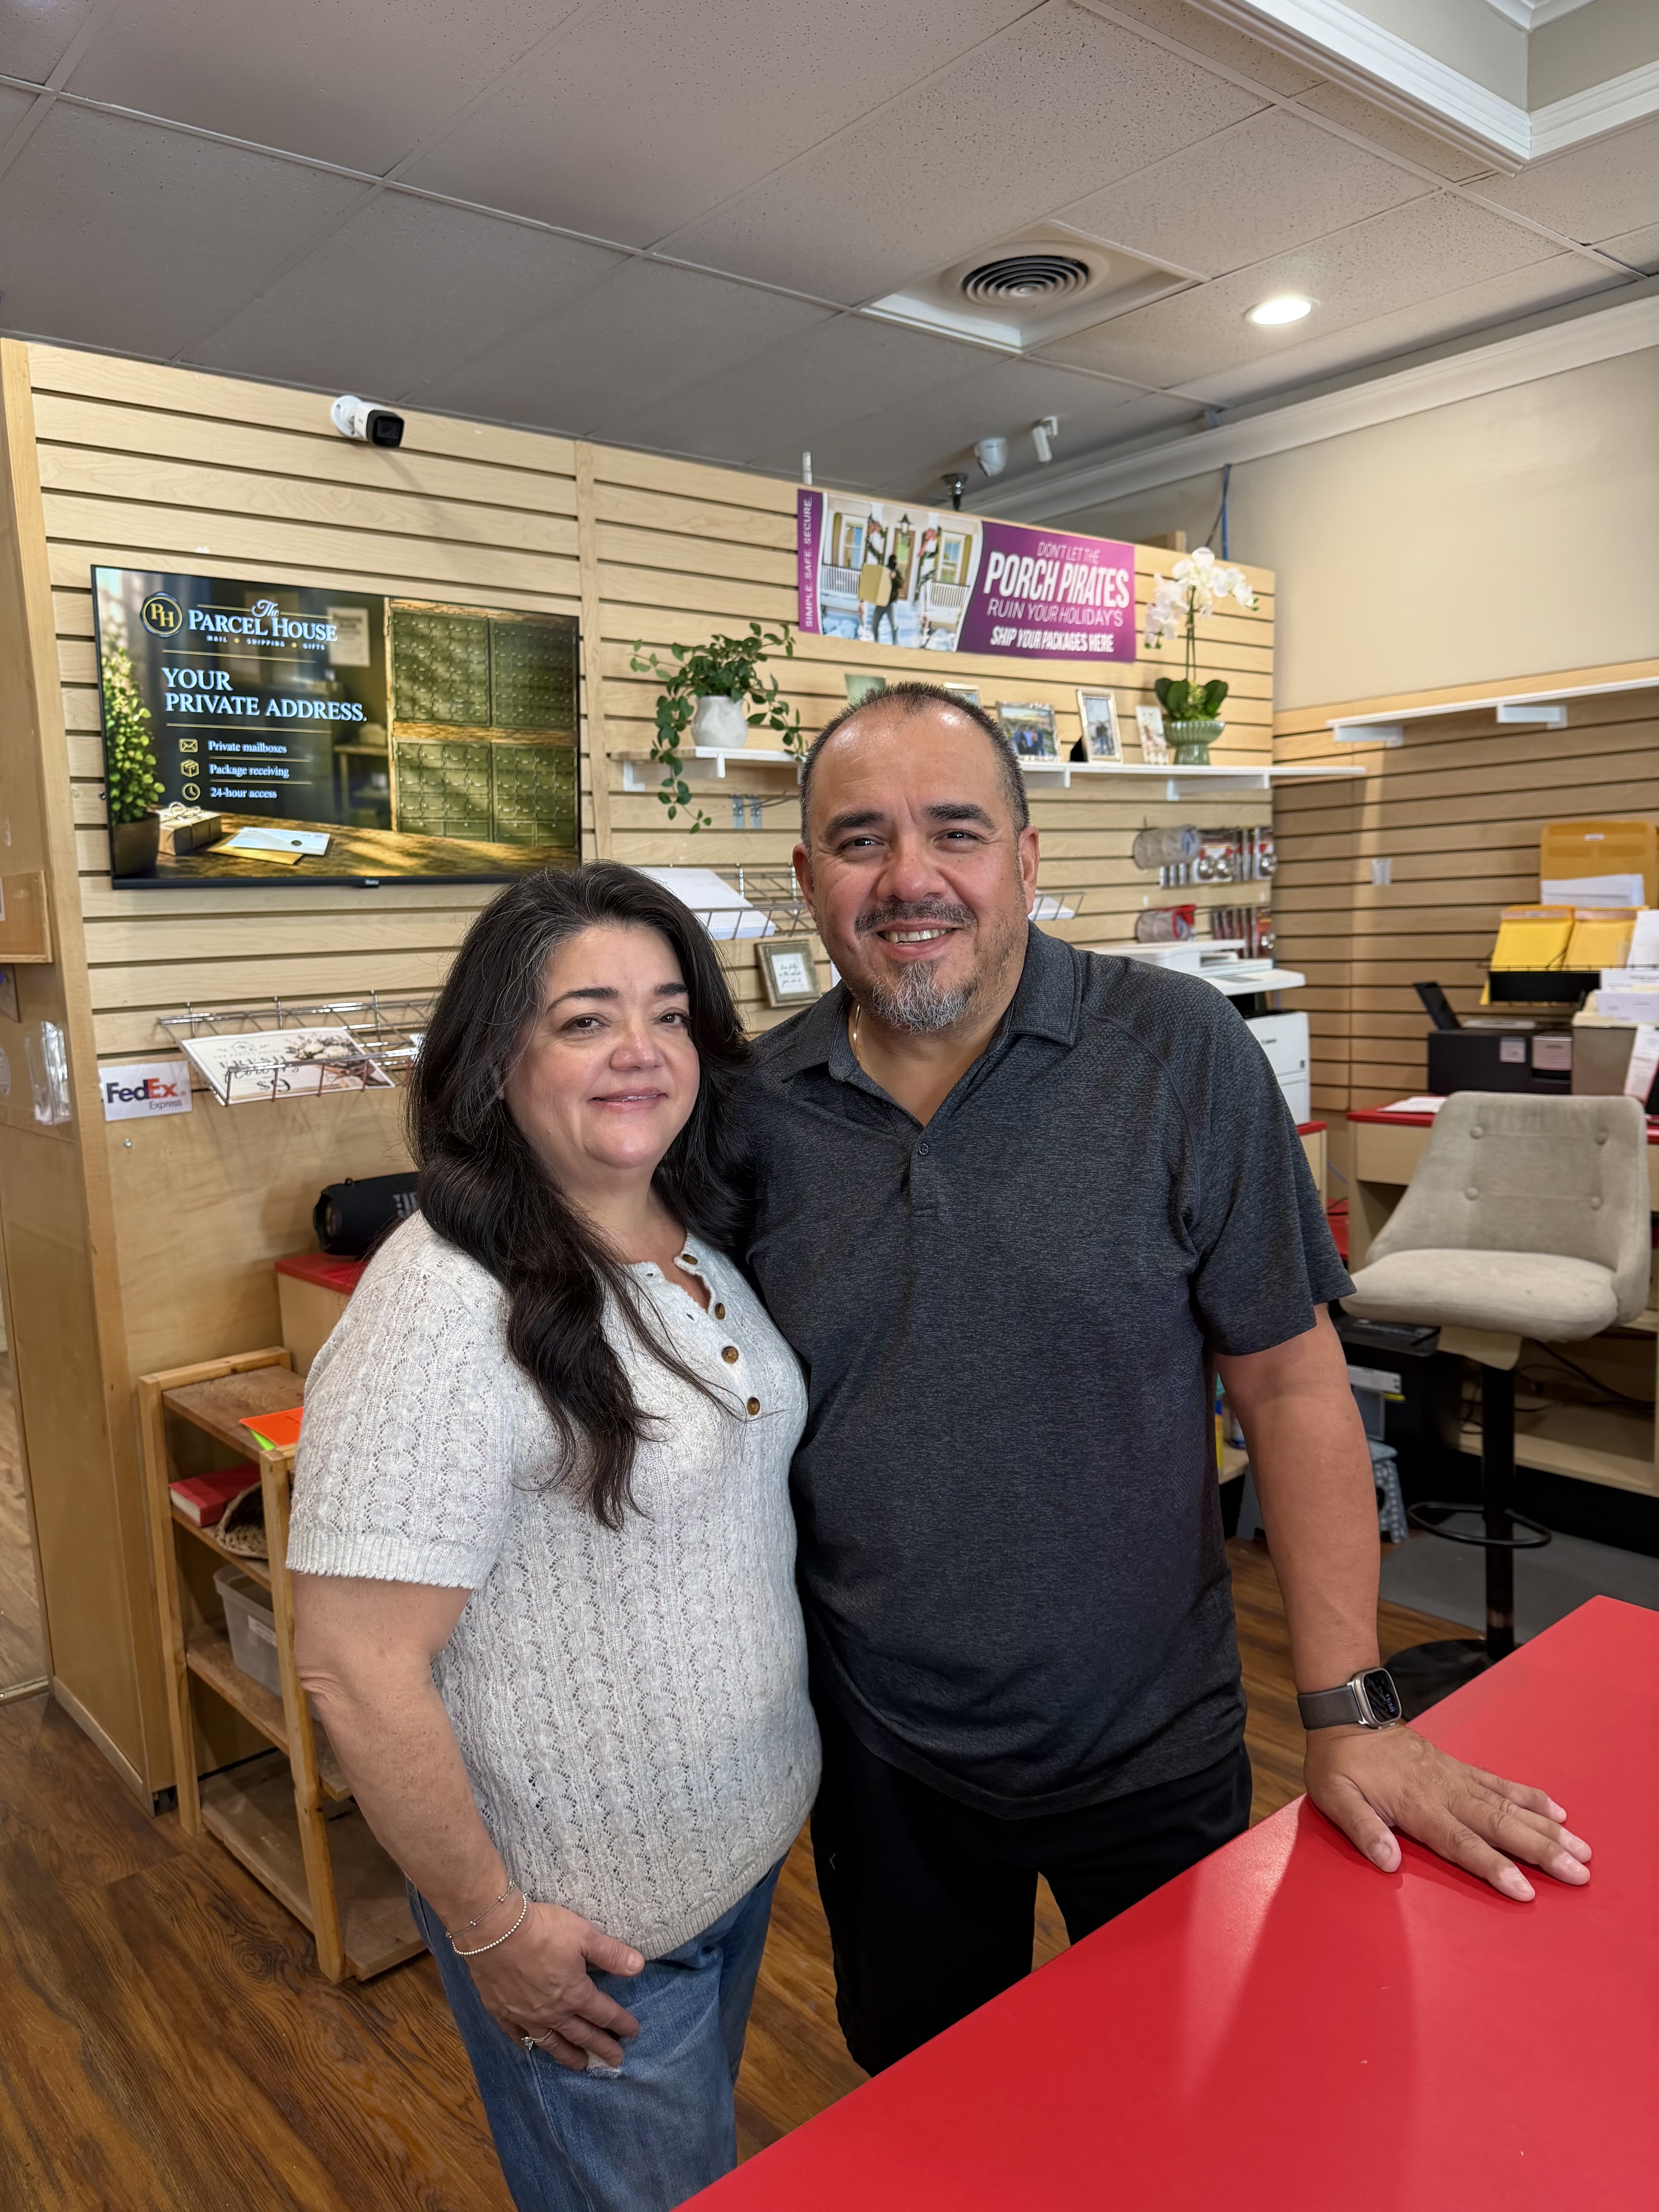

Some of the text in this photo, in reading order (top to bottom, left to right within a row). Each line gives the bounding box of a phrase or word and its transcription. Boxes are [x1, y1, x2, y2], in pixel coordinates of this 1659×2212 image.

[1066, 545, 1084, 562] LET
[983, 550, 1129, 608] PORCH PIRATES
[150, 603, 174, 628] PH
[251, 599, 280, 617] The
[987, 597, 1123, 627] RUIN YOUR HOLIDAY'S
[187, 609, 268, 636] PARCEL
[272, 617, 338, 642] HOUSE
[206, 635, 325, 651] MAIL SHIPPING GIFTS
[990, 625, 1115, 653] SHIP YOUR PACKAGES HERE
[161, 667, 233, 691] YOUR
[165, 692, 367, 721] PRIVATE ADDRESS.
[207, 740, 287, 754] Private mailboxes
[208, 763, 290, 779] Package receiving
[210, 787, 278, 799] 24-hour access
[106, 1078, 177, 1104] FedEx
[149, 1099, 182, 1110] Express
